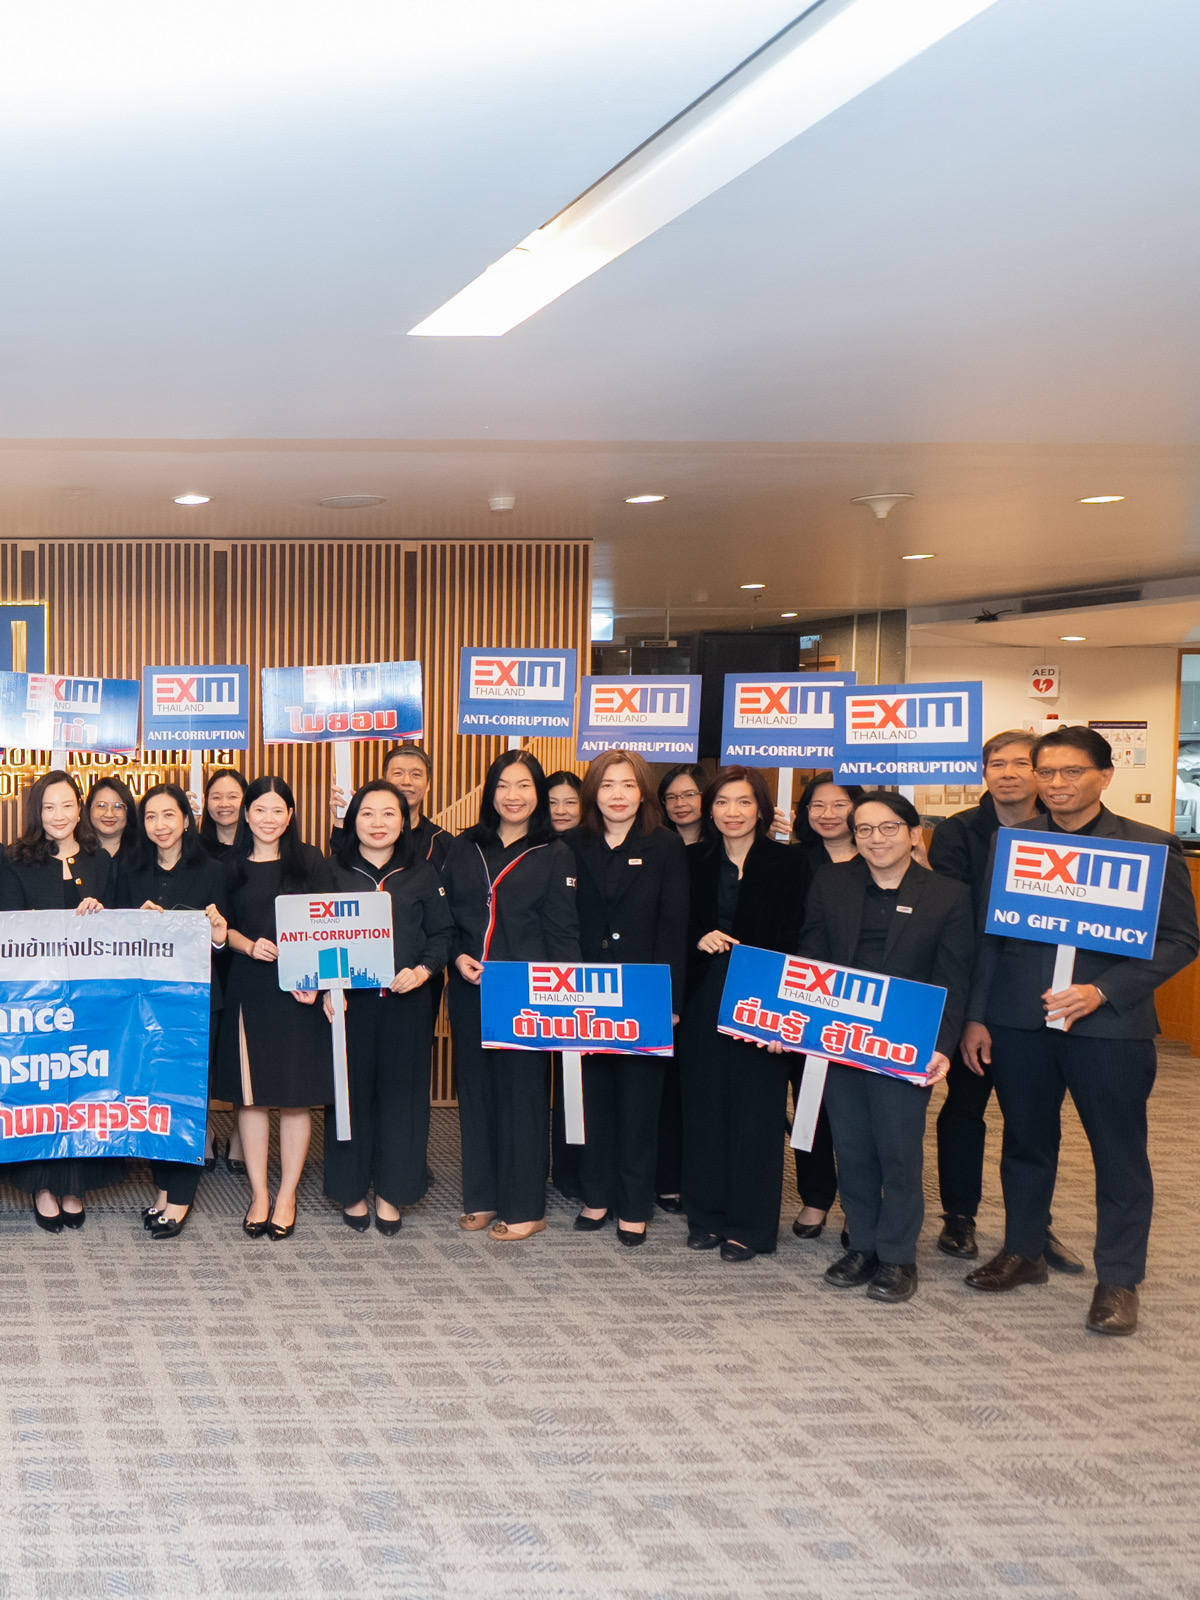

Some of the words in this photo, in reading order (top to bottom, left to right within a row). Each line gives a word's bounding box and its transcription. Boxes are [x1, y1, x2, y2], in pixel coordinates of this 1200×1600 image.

[474, 660, 561, 687] EXIM
[29, 677, 100, 704] EXIM
[156, 677, 235, 702] EXIM
[475, 687, 525, 697] THAILAND
[157, 704, 204, 712] THAILAND
[594, 687, 685, 713] EXIM
[739, 686, 834, 714] EXIM
[284, 706, 398, 733] ไม่ยอม
[462, 714, 569, 727] ANTI-CORRUPTION
[595, 714, 647, 723] THAILAND
[739, 716, 797, 725] THAILAND
[851, 696, 962, 729] EXIM
[148, 730, 245, 741] ANTI-CORRUPTION
[852, 729, 917, 740] THAILAND
[581, 741, 694, 752] ANTI-CORRUPTION
[726, 745, 834, 757] ANTI-CORRUPTI
[839, 761, 977, 774] ANTI-CORRUPTION
[1014, 845, 1142, 892] EXIM
[1013, 878, 1087, 898] THAILAND
[309, 900, 359, 918] EXIM
[280, 928, 390, 942] ANTI-CORRUPTION
[994, 909, 1020, 925] NO
[1027, 914, 1070, 932] GIFT
[1077, 921, 1148, 944] POLICY
[532, 966, 618, 993] EXIM
[784, 960, 885, 1007] EXIM
[533, 993, 584, 1003] THAILAND
[783, 988, 840, 1008] THAILAND
[512, 1008, 640, 1041] ต้านโกง
[733, 997, 810, 1044] ตื่นรู้
[820, 1020, 918, 1065] สู้โกง
